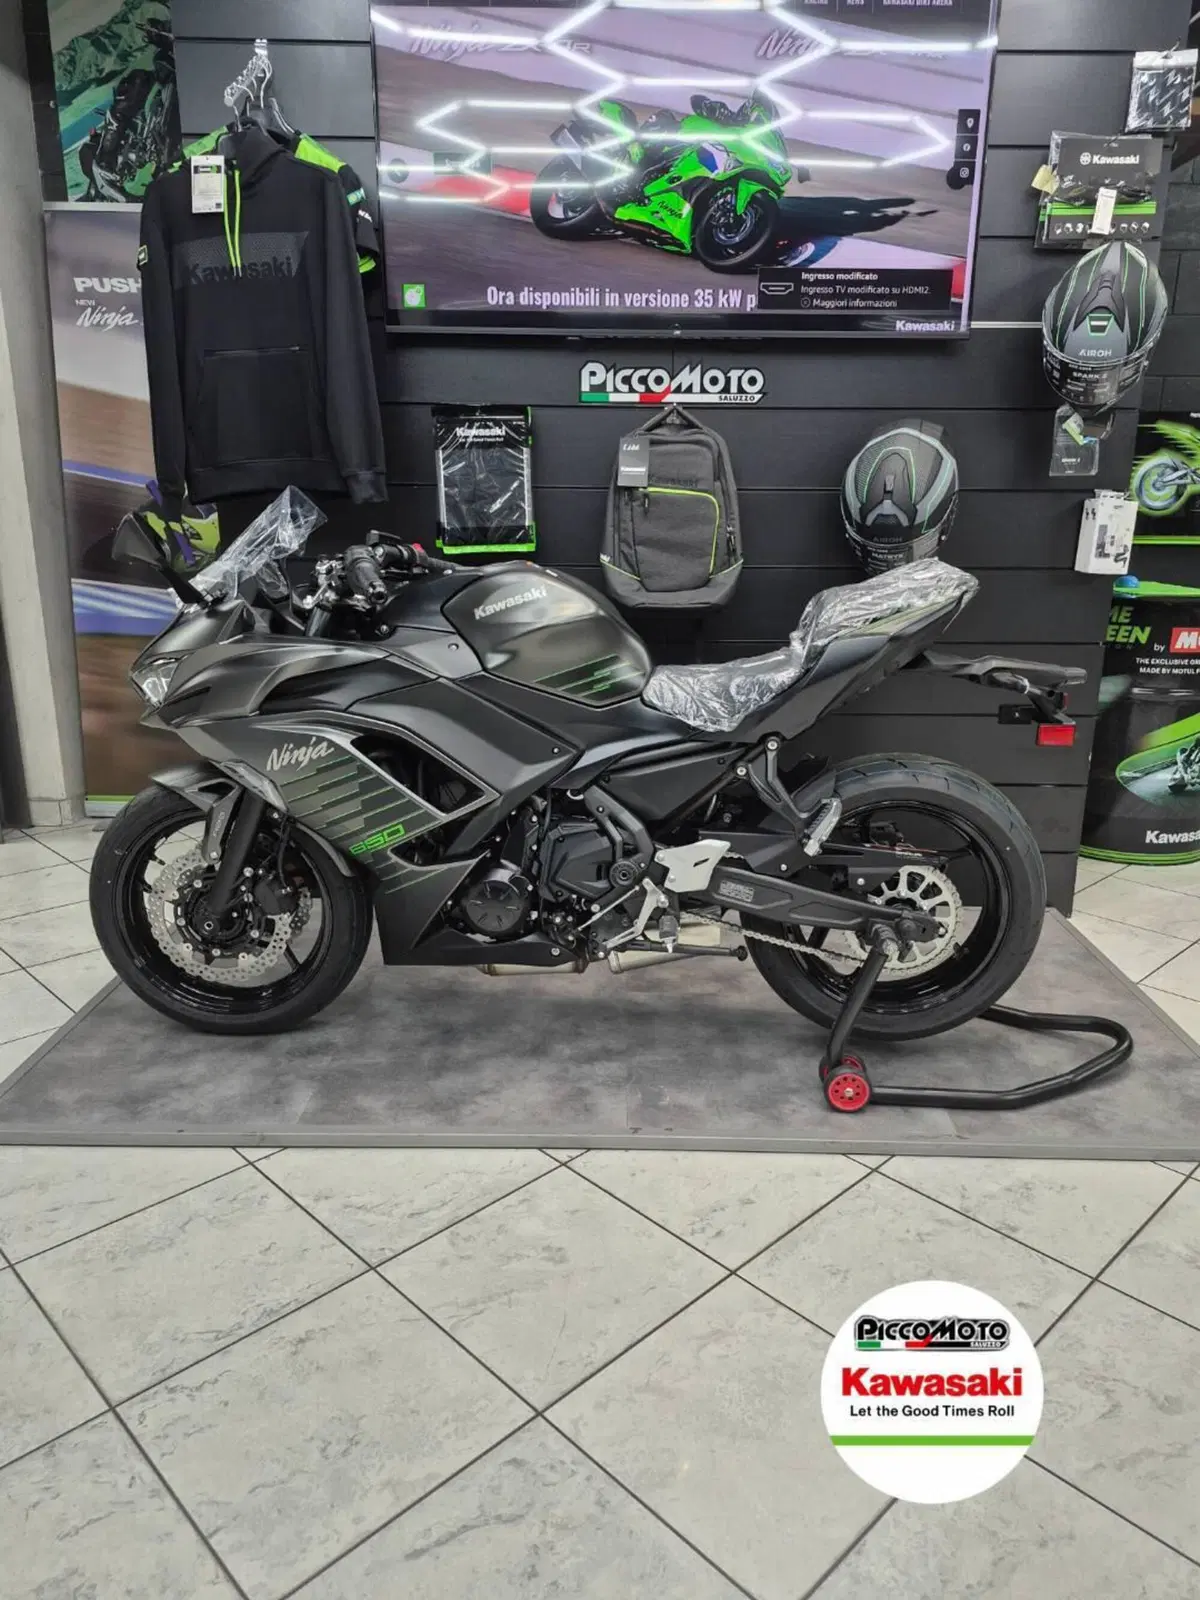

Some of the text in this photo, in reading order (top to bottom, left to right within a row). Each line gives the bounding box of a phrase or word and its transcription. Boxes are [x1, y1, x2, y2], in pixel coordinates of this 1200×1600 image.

[1092, 154, 1140, 165] Kawasaki
[801, 270, 878, 281] Ingresso modificato
[800, 285, 834, 295] Ingresso
[835, 285, 846, 294] TV
[847, 284, 889, 295] modificato
[487, 286, 515, 306] Ora
[519, 286, 600, 310] disponibili
[605, 288, 620, 306] in
[624, 288, 689, 308] versione
[694, 289, 713, 308] 35
[718, 289, 742, 309] kW
[812, 298, 898, 309] Maggiori informazioni
[76, 306, 139, 332] Ninja
[895, 320, 955, 331] Kawasaki
[1078, 348, 1113, 358] AIROH
[473, 584, 549, 621] Kawasaki
[1153, 630, 1200, 653] by M
[1135, 657, 1150, 666] THE
[1151, 658, 1188, 667] EXCLUSIVE
[1139, 667, 1161, 675] MADE
[1171, 668, 1195, 676] MOTUL
[265, 736, 336, 773] Ninja
[349, 823, 405, 855] 650
